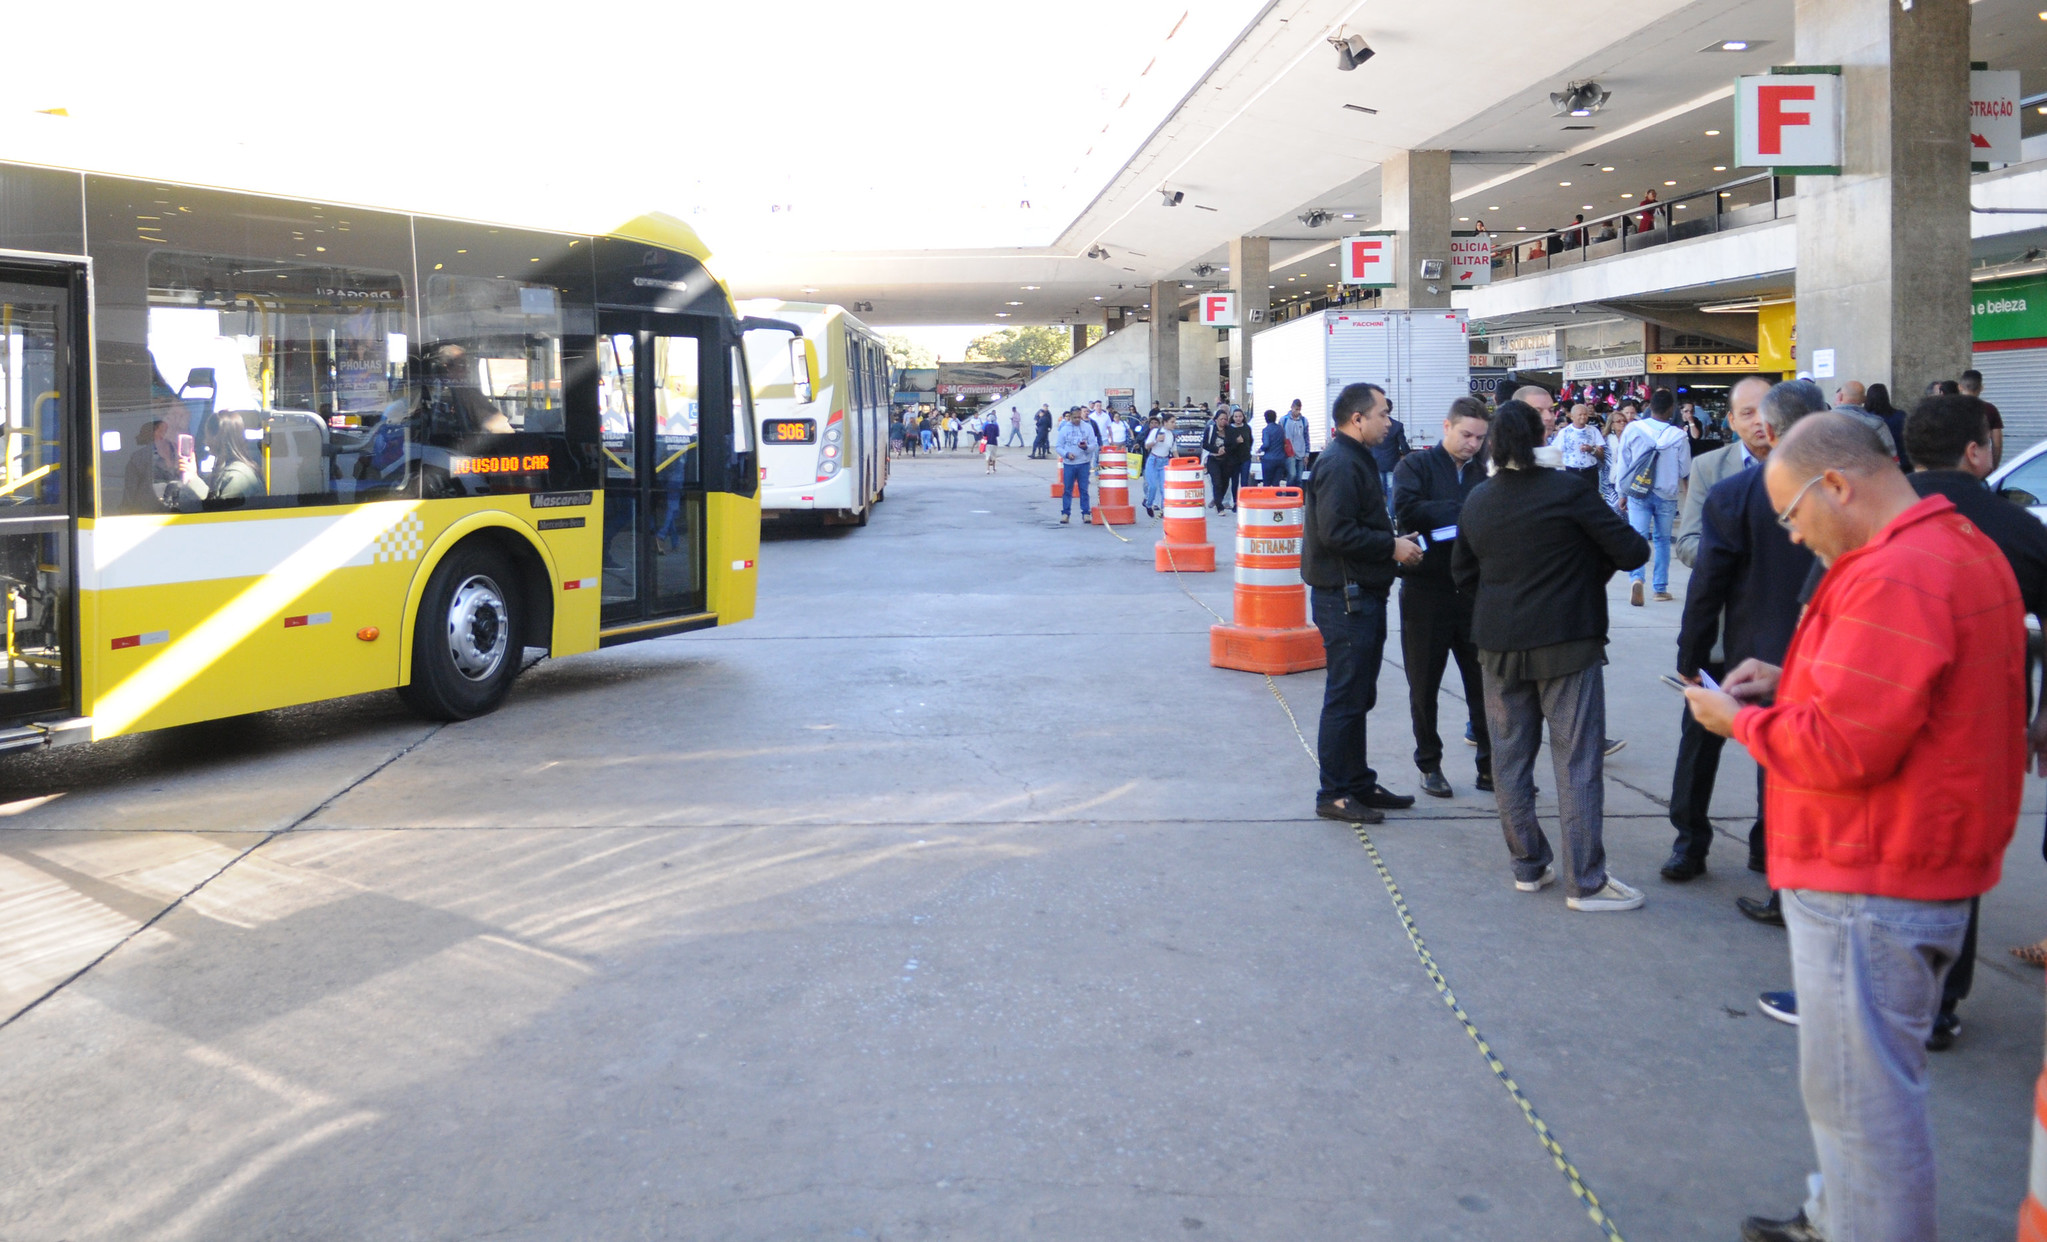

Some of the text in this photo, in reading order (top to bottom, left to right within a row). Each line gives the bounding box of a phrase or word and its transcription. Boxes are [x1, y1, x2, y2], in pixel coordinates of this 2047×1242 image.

[1758, 85, 1815, 155] F
[1352, 241, 1382, 278] F
[1207, 297, 1227, 321] F
[1977, 303, 1985, 315] e
[1987, 298, 2027, 314] beleza
[1478, 355, 1488, 366] EM
[1493, 355, 1517, 367] MINUTO
[1574, 360, 1602, 373] ARITANA
[1604, 355, 1644, 370] NOVIDADES
[777, 423, 805, 440] 906
[472, 457, 499, 473] USO
[500, 456, 519, 472] DO
[522, 455, 550, 471] CAR
[533, 493, 591, 508] Mascarello
[1250, 539, 1297, 554] DETRAN-DF
